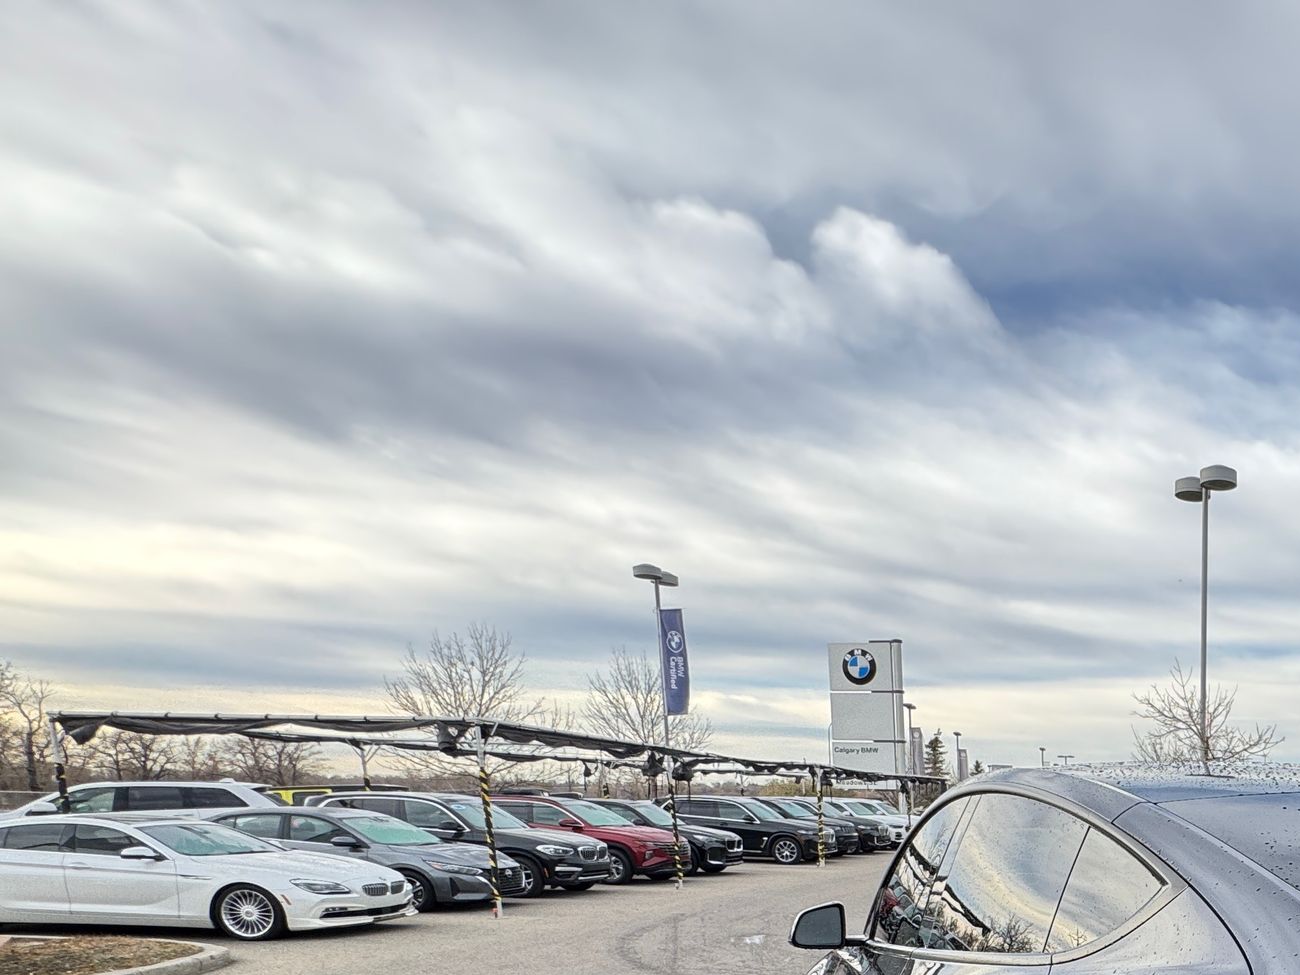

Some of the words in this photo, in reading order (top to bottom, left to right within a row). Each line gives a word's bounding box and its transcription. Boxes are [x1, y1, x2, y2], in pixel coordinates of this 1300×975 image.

[669, 656, 678, 690] Certified
[676, 656, 685, 678] BMW
[834, 746, 860, 755] Calgary
